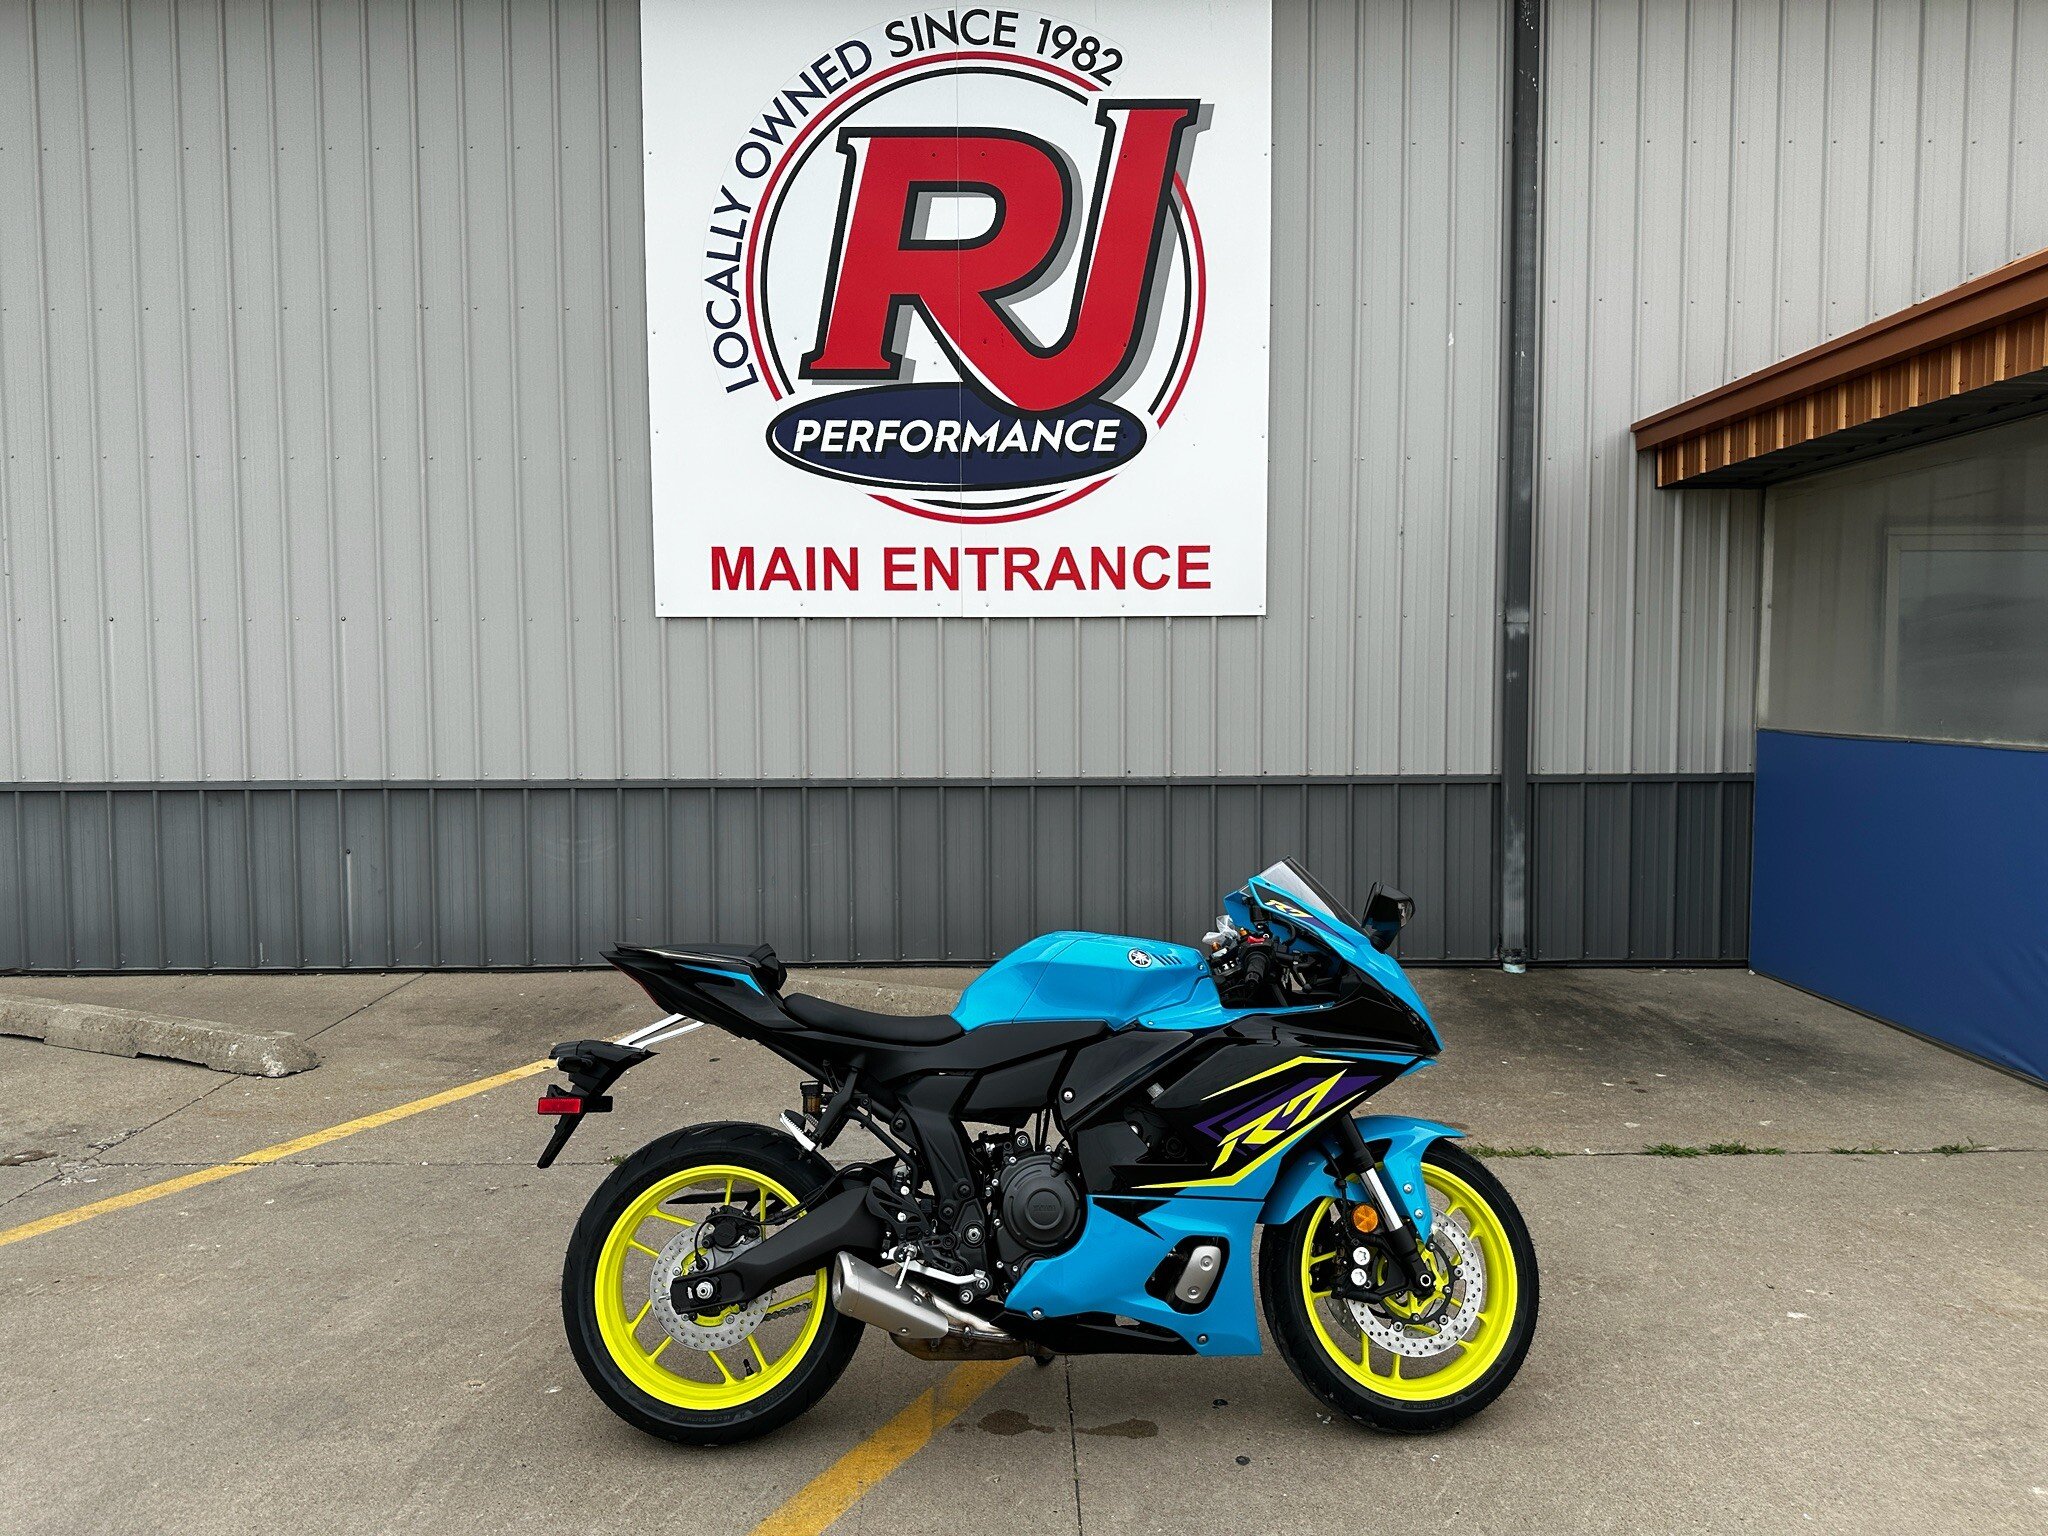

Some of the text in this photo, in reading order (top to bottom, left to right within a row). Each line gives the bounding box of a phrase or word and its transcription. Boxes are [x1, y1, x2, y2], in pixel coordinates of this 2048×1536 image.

[705, 9, 1123, 393] LOCALLY OWNED SINCE 1982
[799, 99, 1201, 416] RJ
[793, 418, 1121, 453] PERFORMANCE
[711, 545, 1211, 591] MAIN ENTRANCE
[1211, 1069, 1348, 1172] R7
